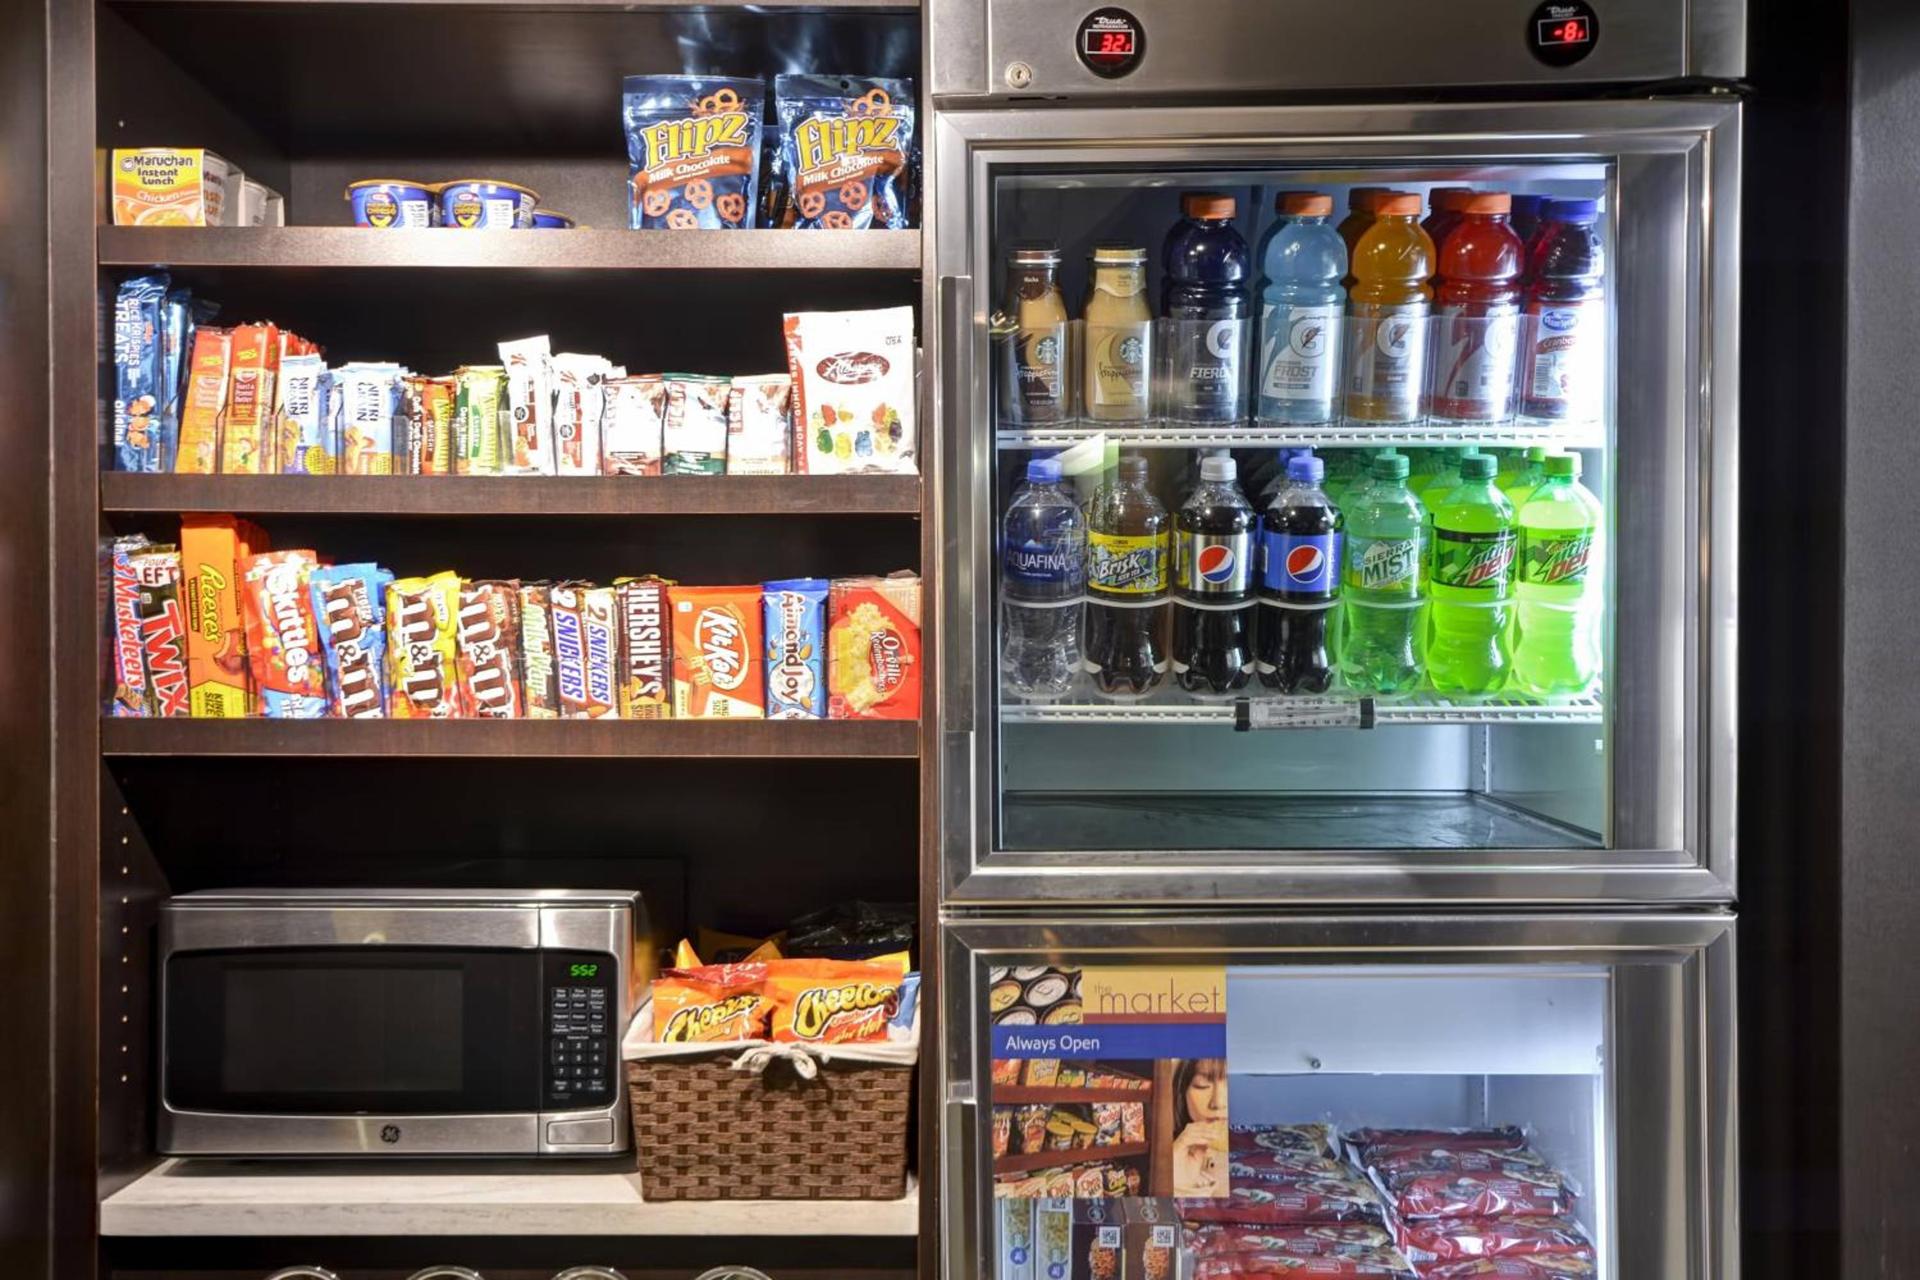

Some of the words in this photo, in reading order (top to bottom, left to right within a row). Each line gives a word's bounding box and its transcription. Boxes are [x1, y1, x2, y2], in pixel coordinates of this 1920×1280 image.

[134, 156, 193, 166] Maruchan
[643, 113, 747, 172] Flipz
[796, 116, 899, 174] Flipz
[138, 169, 178, 177] Instant
[142, 177, 174, 185] Lunch
[649, 168, 672, 184] Milk
[676, 155, 731, 175] Chocolate
[803, 171, 828, 186] Milk
[831, 155, 884, 179] Chocolate
[127, 298, 141, 321] RICE
[114, 300, 131, 365] TREATS
[127, 322, 142, 367] KRISPIES
[1273, 365, 1318, 377] FROST
[289, 377, 300, 416] GRAIN
[299, 377, 310, 415] NUTRI
[368, 383, 380, 422] NUTRI
[792, 382, 802, 417] GUMMI
[114, 400, 127, 448] original
[1364, 547, 1413, 585] MIST
[200, 563, 227, 643] Reese's
[588, 604, 608, 622] 2
[114, 576, 145, 689] Musketeers
[266, 567, 310, 684] Skittles
[628, 586, 662, 698] HERSHEY'S
[702, 609, 739, 647] Kit
[782, 592, 805, 667] Almond
[143, 601, 189, 718] TWIX
[556, 611, 584, 700] SNICKERS
[590, 625, 609, 702] SNICKERS
[703, 643, 740, 688] Kat
[881, 636, 901, 684] Orville
[204, 692, 214, 715] SIZE
[782, 667, 804, 703] Joy
[794, 985, 900, 1041] Cheetos
[1100, 977, 1222, 1014] market
[1006, 1035, 1057, 1054] Always
[1060, 1034, 1100, 1054] Open
